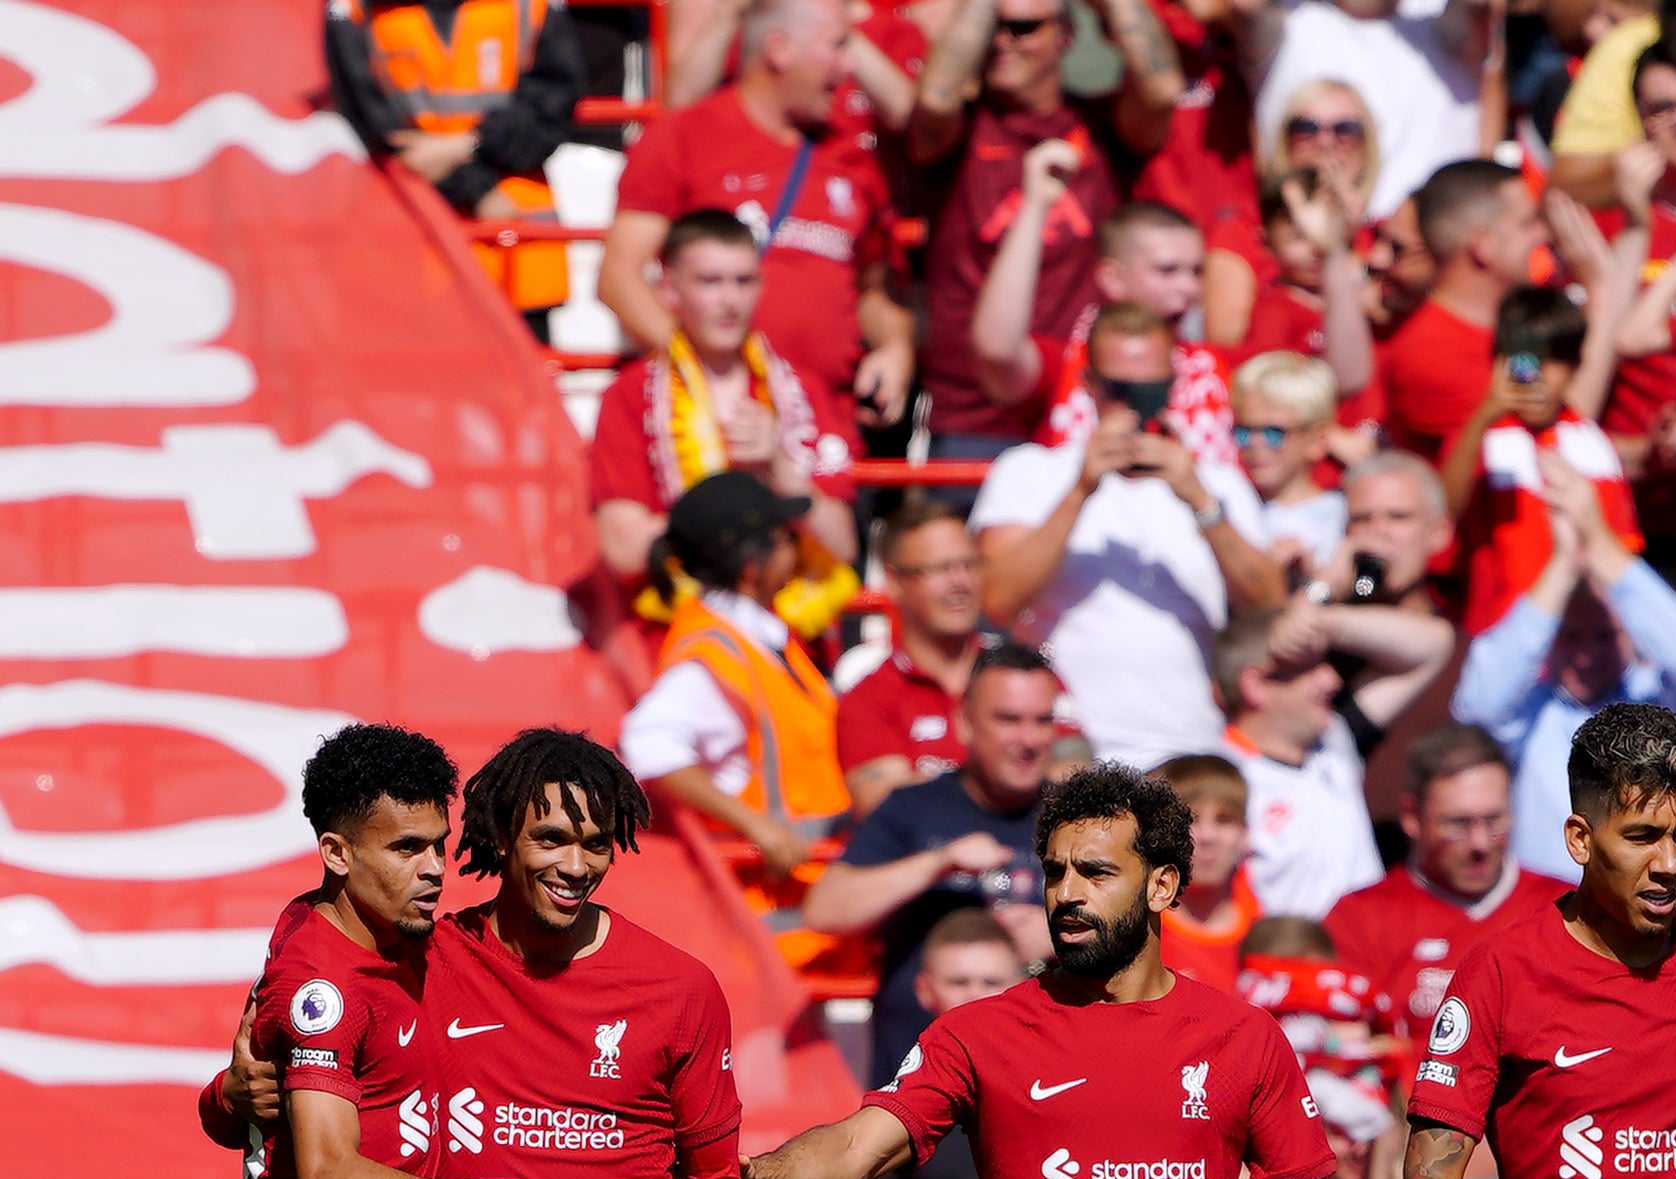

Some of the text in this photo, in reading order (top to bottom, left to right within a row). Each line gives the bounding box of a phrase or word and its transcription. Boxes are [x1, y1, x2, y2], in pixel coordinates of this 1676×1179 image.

[303, 1049, 334, 1061] room
[494, 1102, 617, 1132] standard
[493, 1124, 625, 1149] chartered
